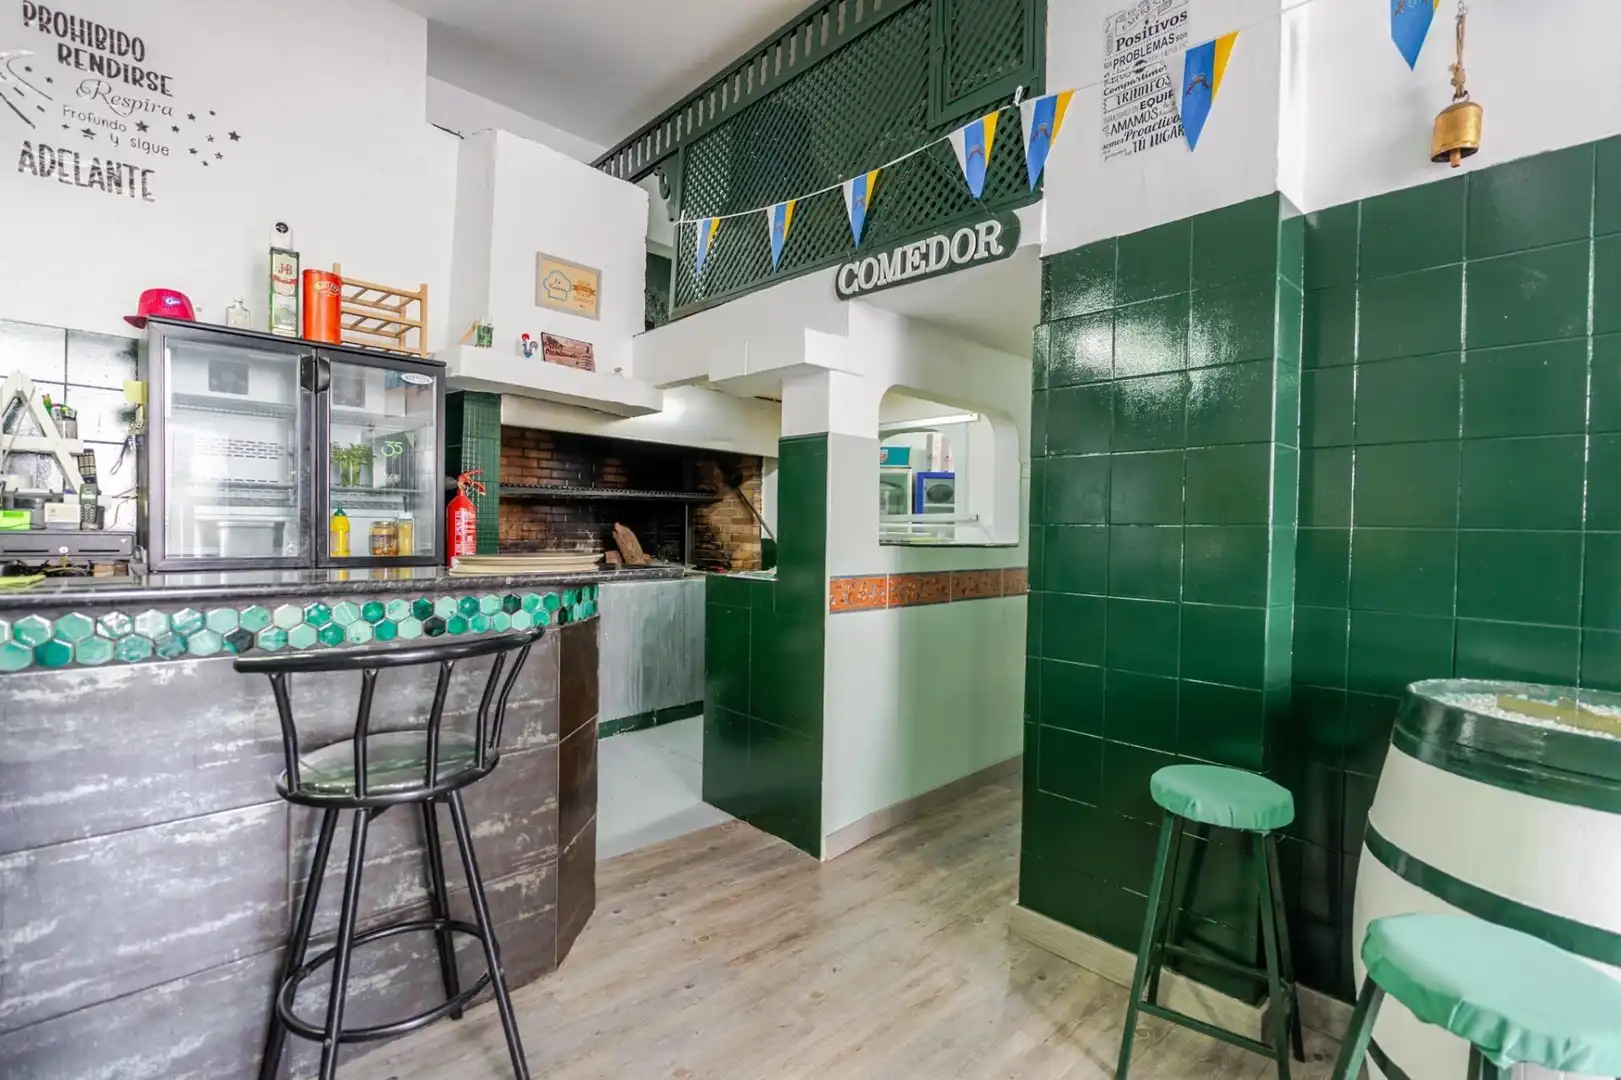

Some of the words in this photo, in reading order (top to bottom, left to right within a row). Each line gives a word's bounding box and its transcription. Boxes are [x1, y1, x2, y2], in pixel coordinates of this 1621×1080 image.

[22, 0, 146, 62] PROHIBIDO
[1115, 10, 1188, 52] Positivos
[57, 42, 174, 97] RENDIRSE
[1112, 33, 1175, 70] PROBLEMAS
[76, 78, 174, 117] Respira
[62, 104, 127, 133] Profundo
[1110, 107, 1159, 137] AMAMOS
[1124, 113, 1183, 143] Proactivo
[110, 133, 119, 147] y
[130, 136, 170, 156] sigue
[18, 140, 156, 203] ADELANTE
